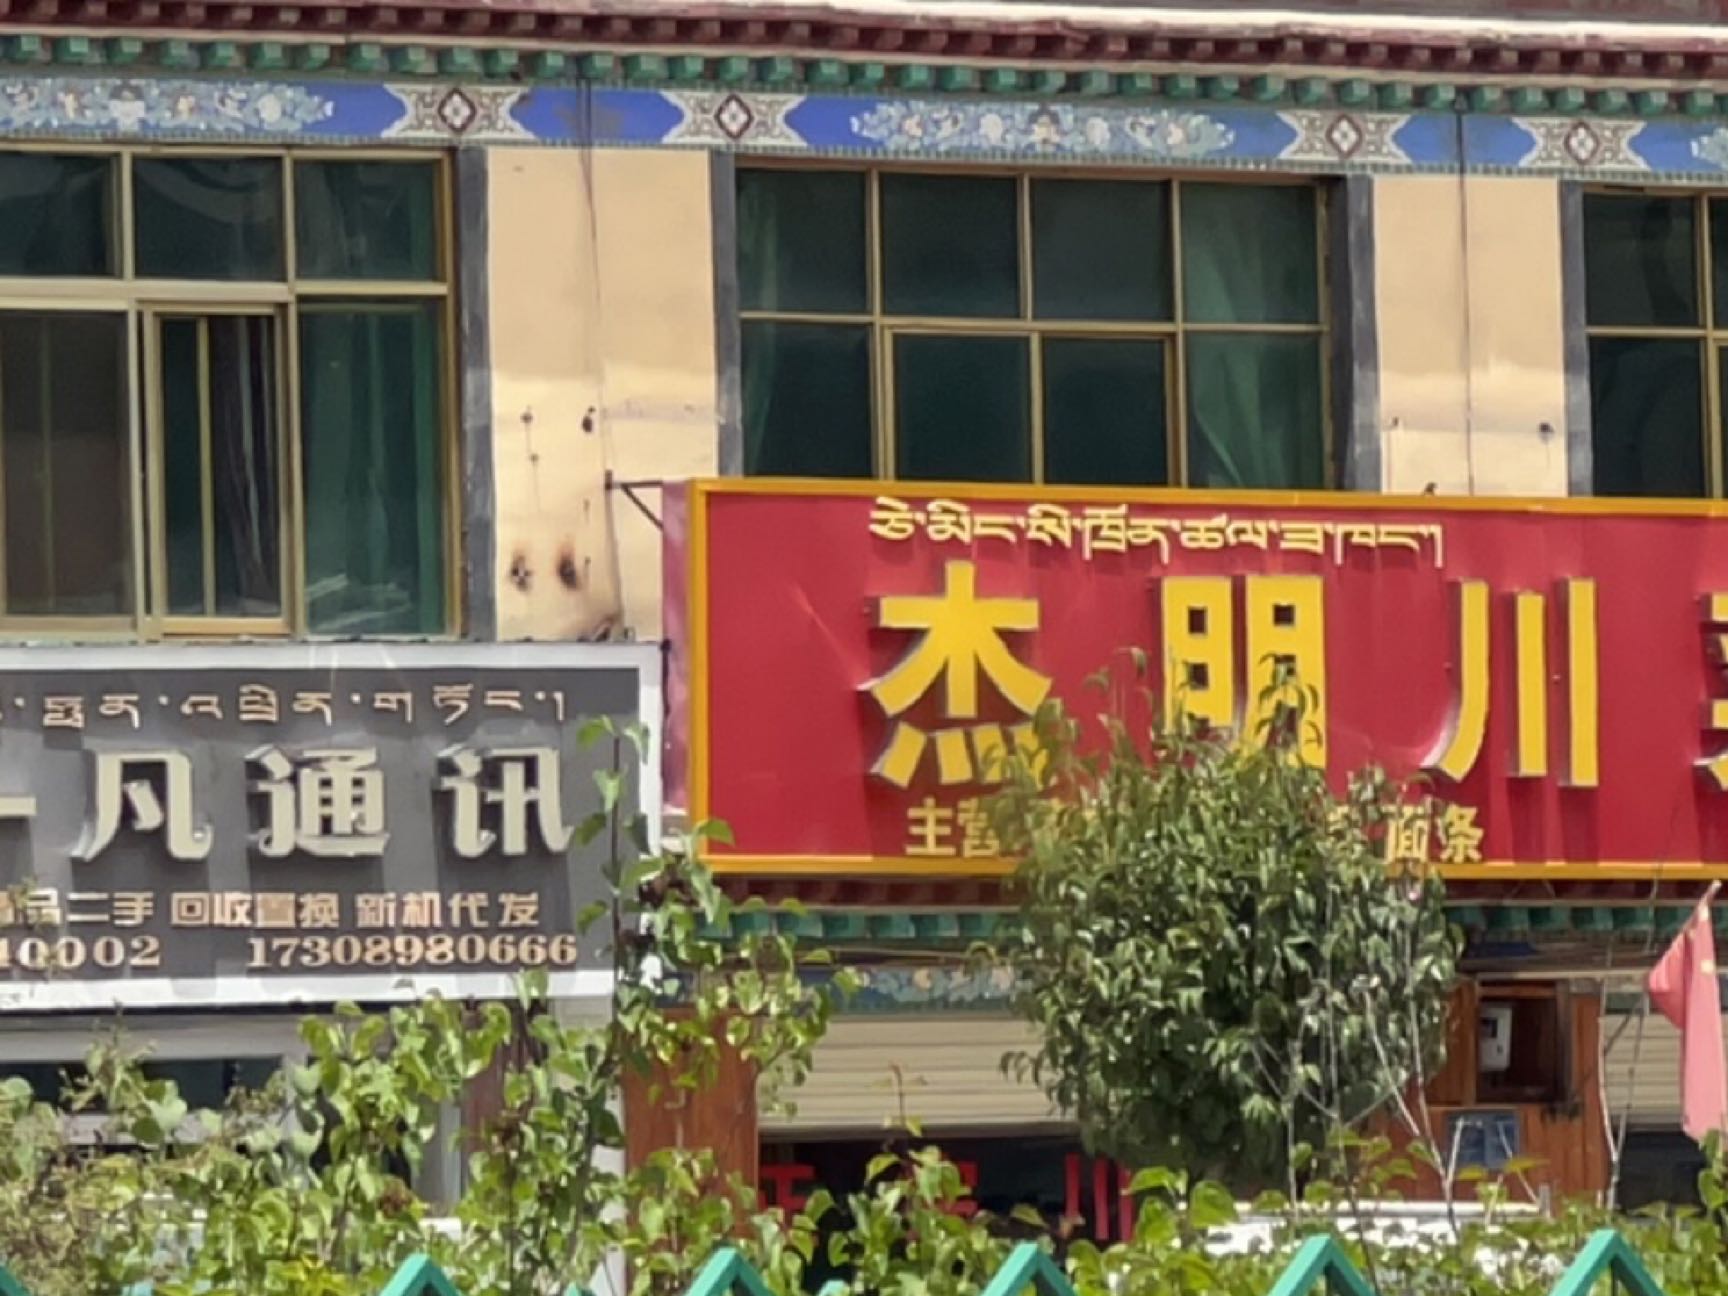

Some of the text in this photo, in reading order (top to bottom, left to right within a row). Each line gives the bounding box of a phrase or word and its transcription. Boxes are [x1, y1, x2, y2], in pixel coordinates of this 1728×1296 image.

[0, 744, 577, 862] 凡通讯
[356, 892, 539, 928] 新机代发
[247, 934, 578, 968] 17308980666
